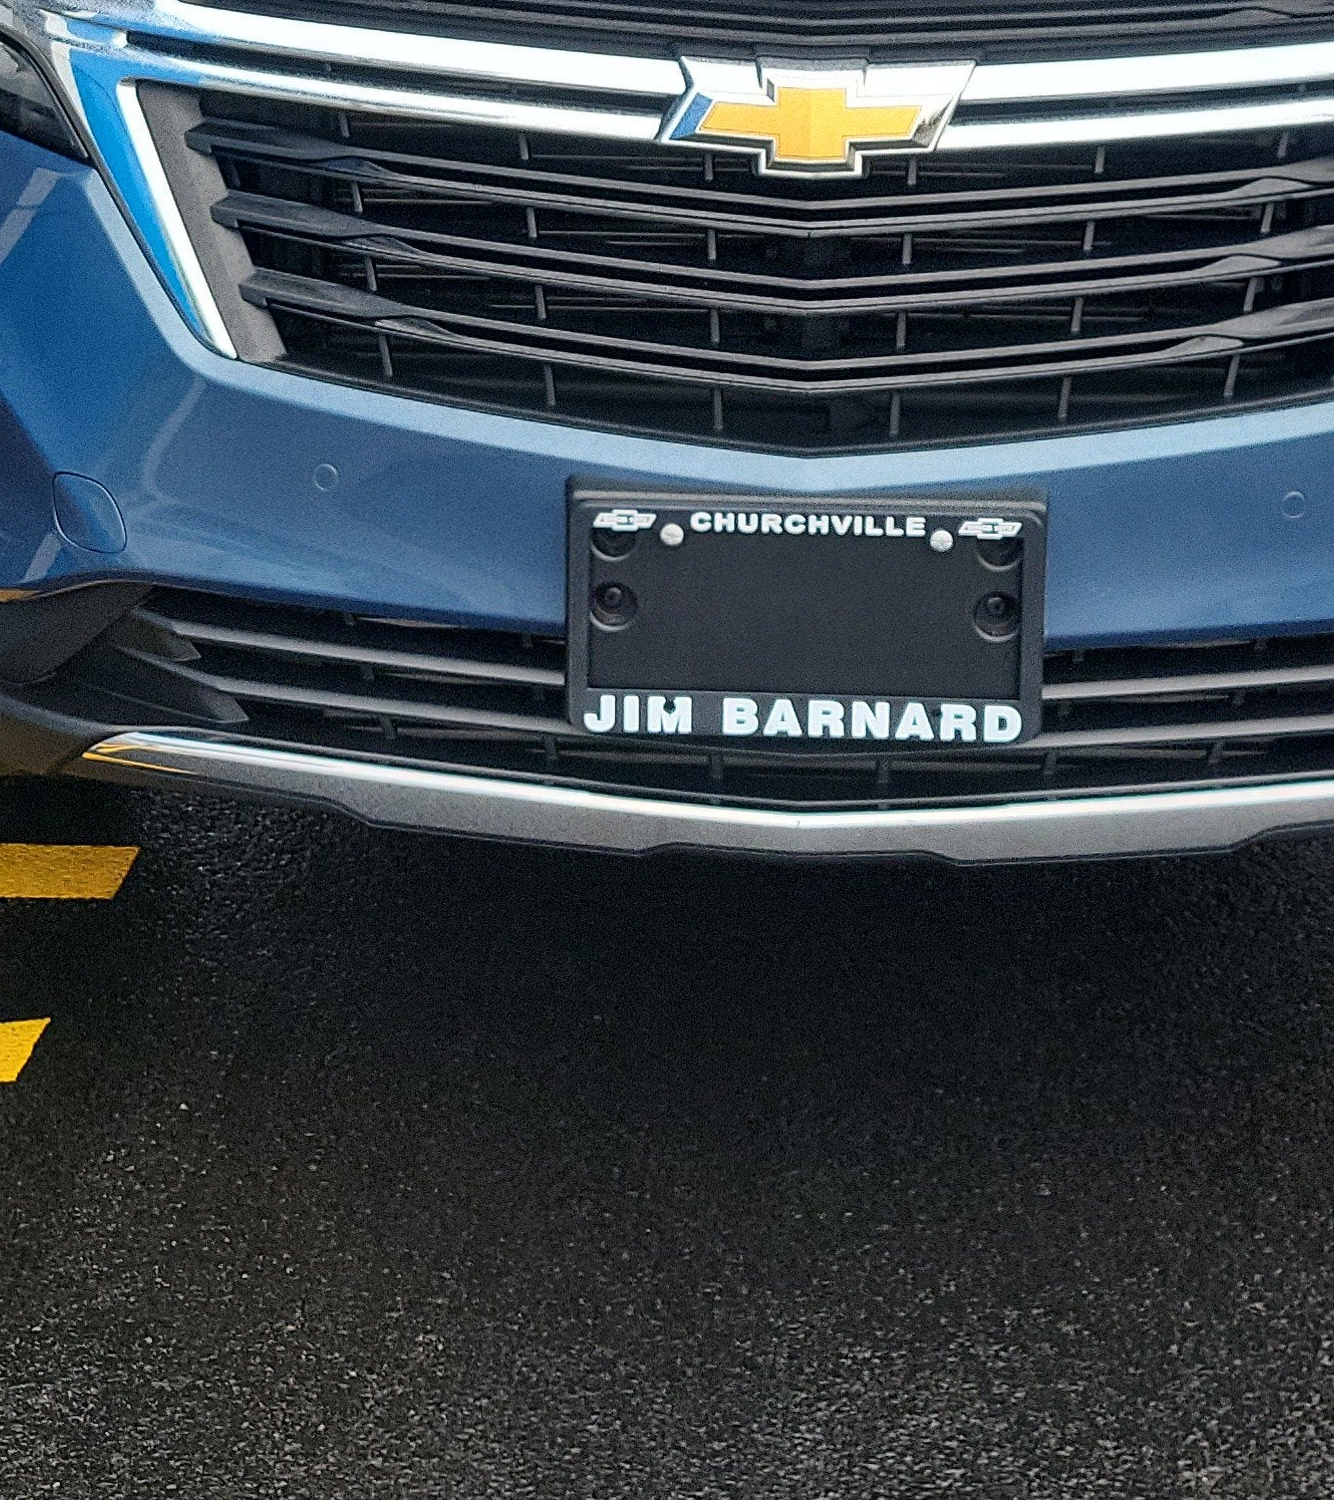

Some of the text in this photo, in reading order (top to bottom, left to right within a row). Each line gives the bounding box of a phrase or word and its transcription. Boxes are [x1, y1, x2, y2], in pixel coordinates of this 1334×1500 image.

[689, 511, 927, 537] CHURCHVILLE
[583, 694, 1022, 741] JIM BARNARD
